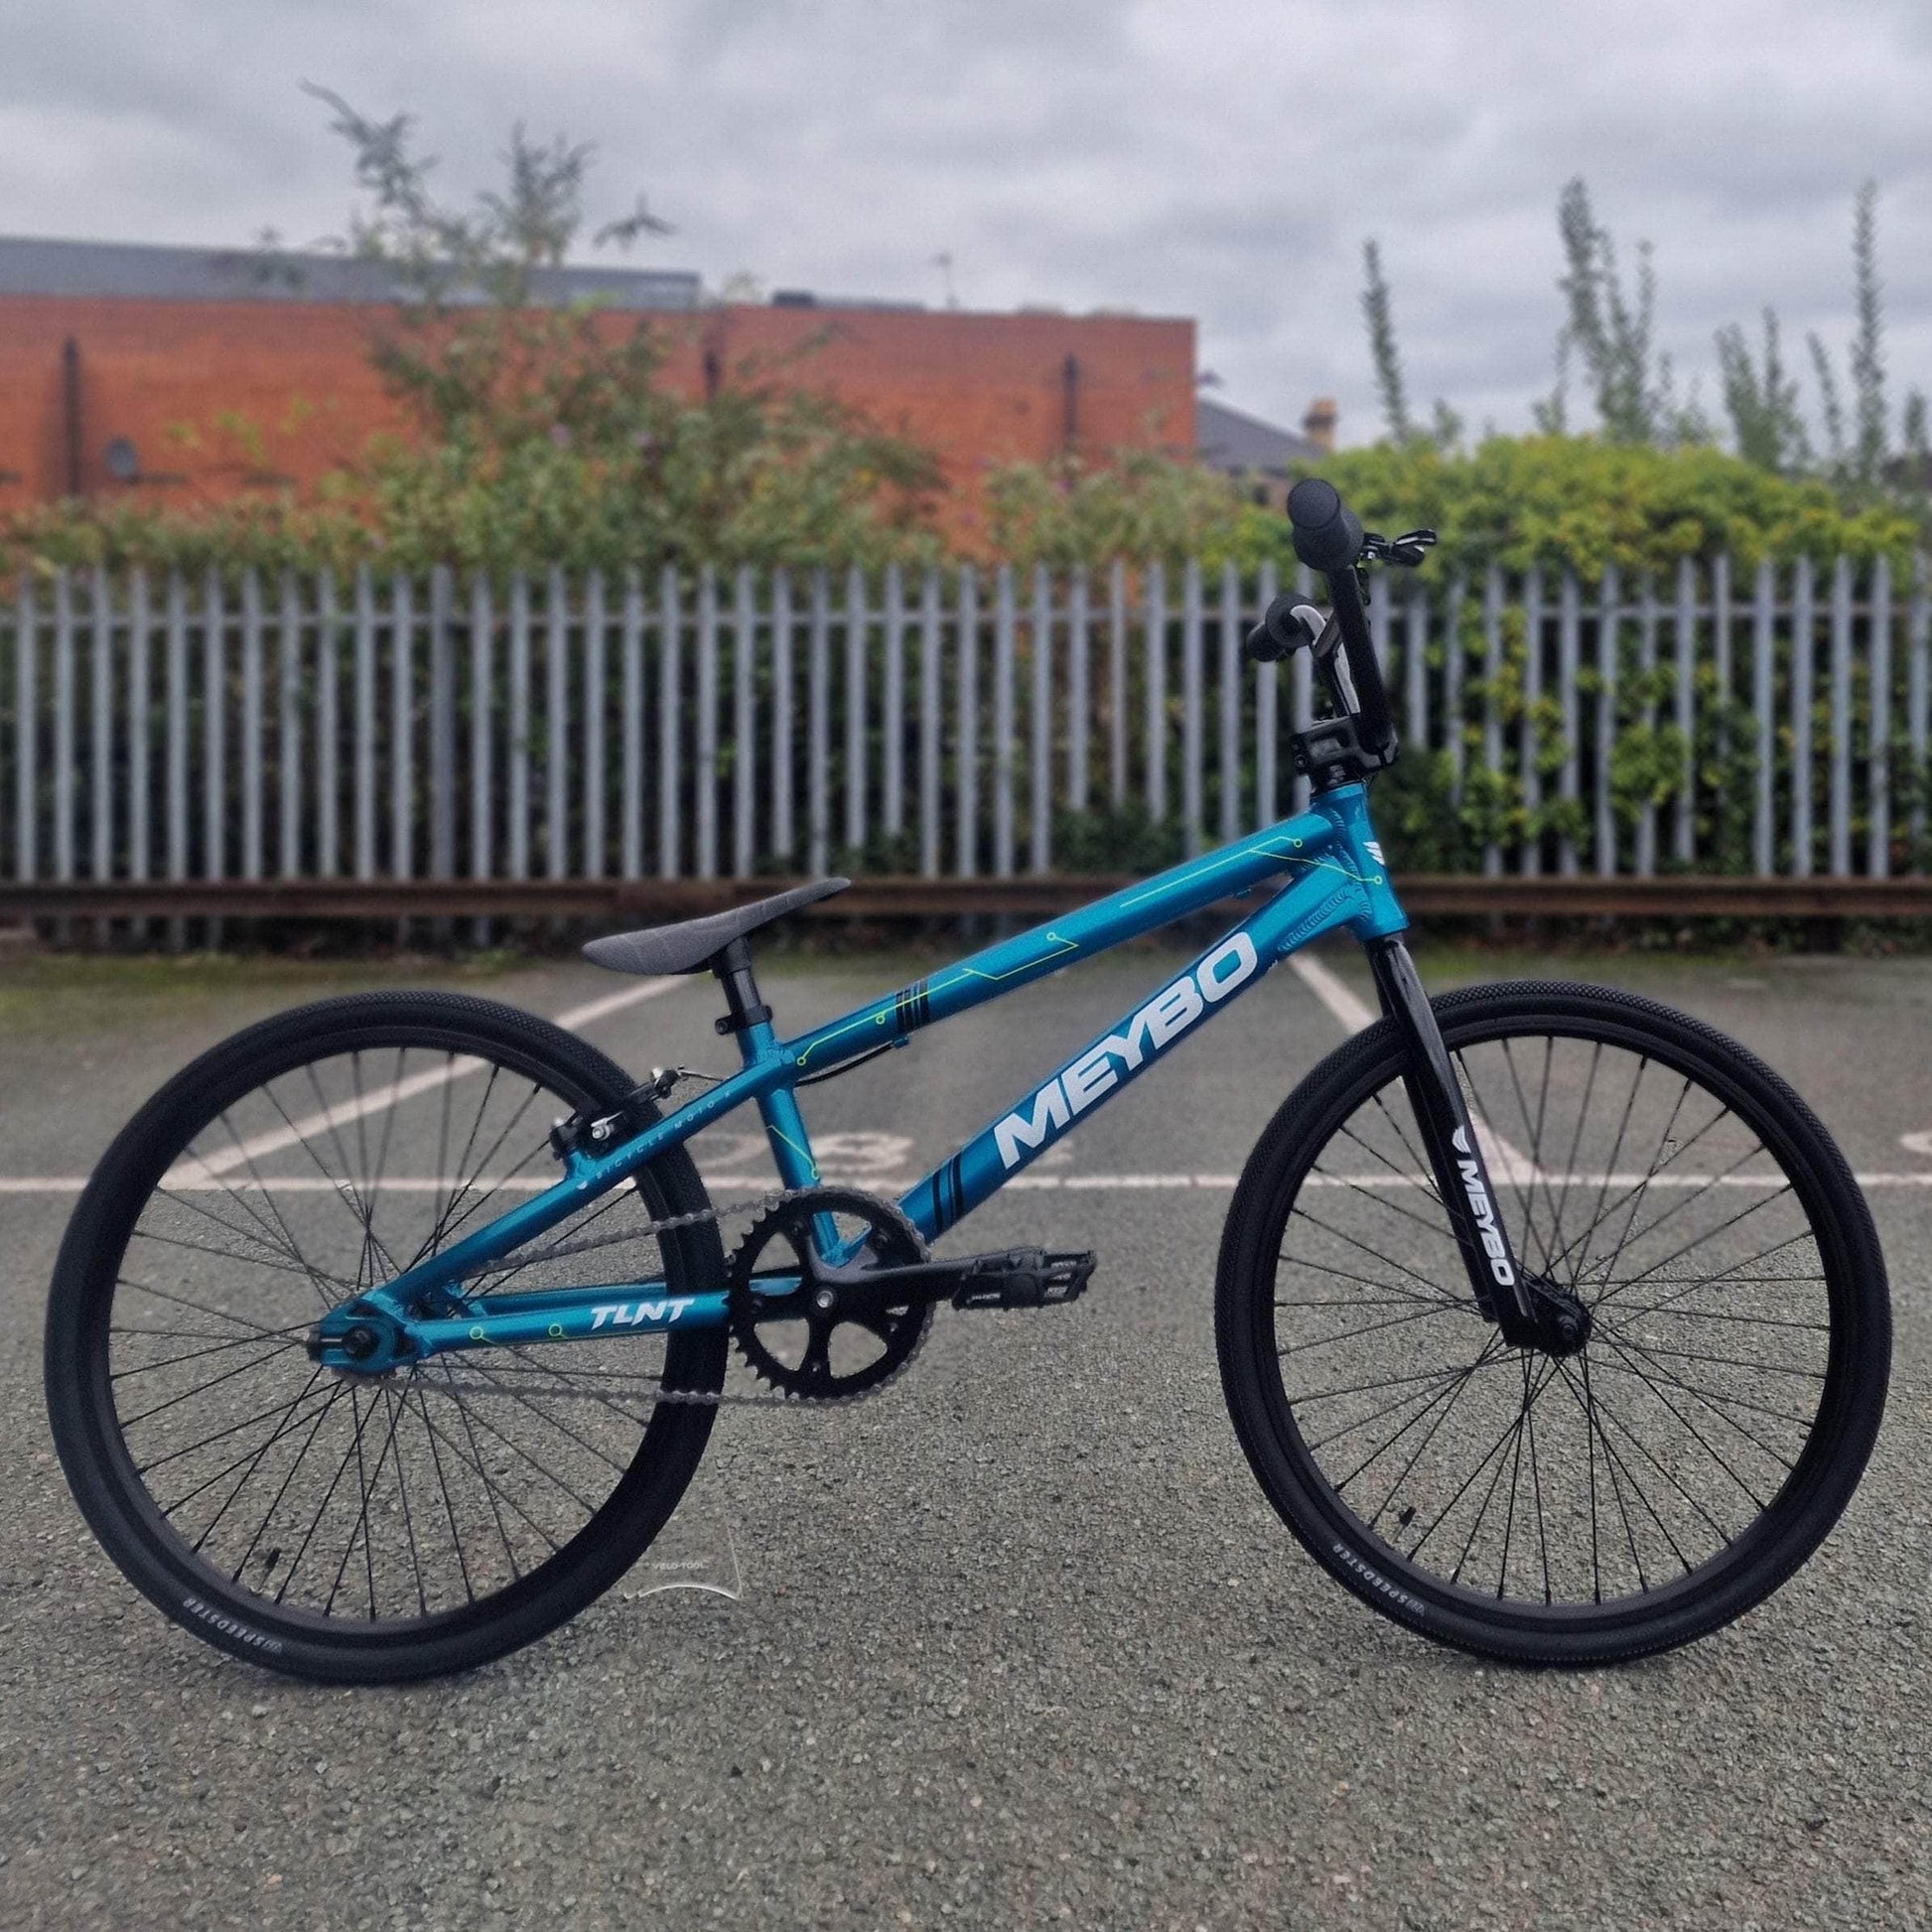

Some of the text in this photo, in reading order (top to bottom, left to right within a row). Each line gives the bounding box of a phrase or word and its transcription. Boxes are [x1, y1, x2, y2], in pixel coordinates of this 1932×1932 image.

[994, 931, 1258, 1171] MEYBO
[597, 1133, 663, 1179] BICYCLE
[674, 1100, 715, 1130] MOTO
[1456, 1160, 1515, 1286] MEYBO
[591, 1299, 695, 1331] TLNT
[1332, 1543, 1408, 1604] SPEEDSTER
[183, 1597, 266, 1647] SPEEDSTER
